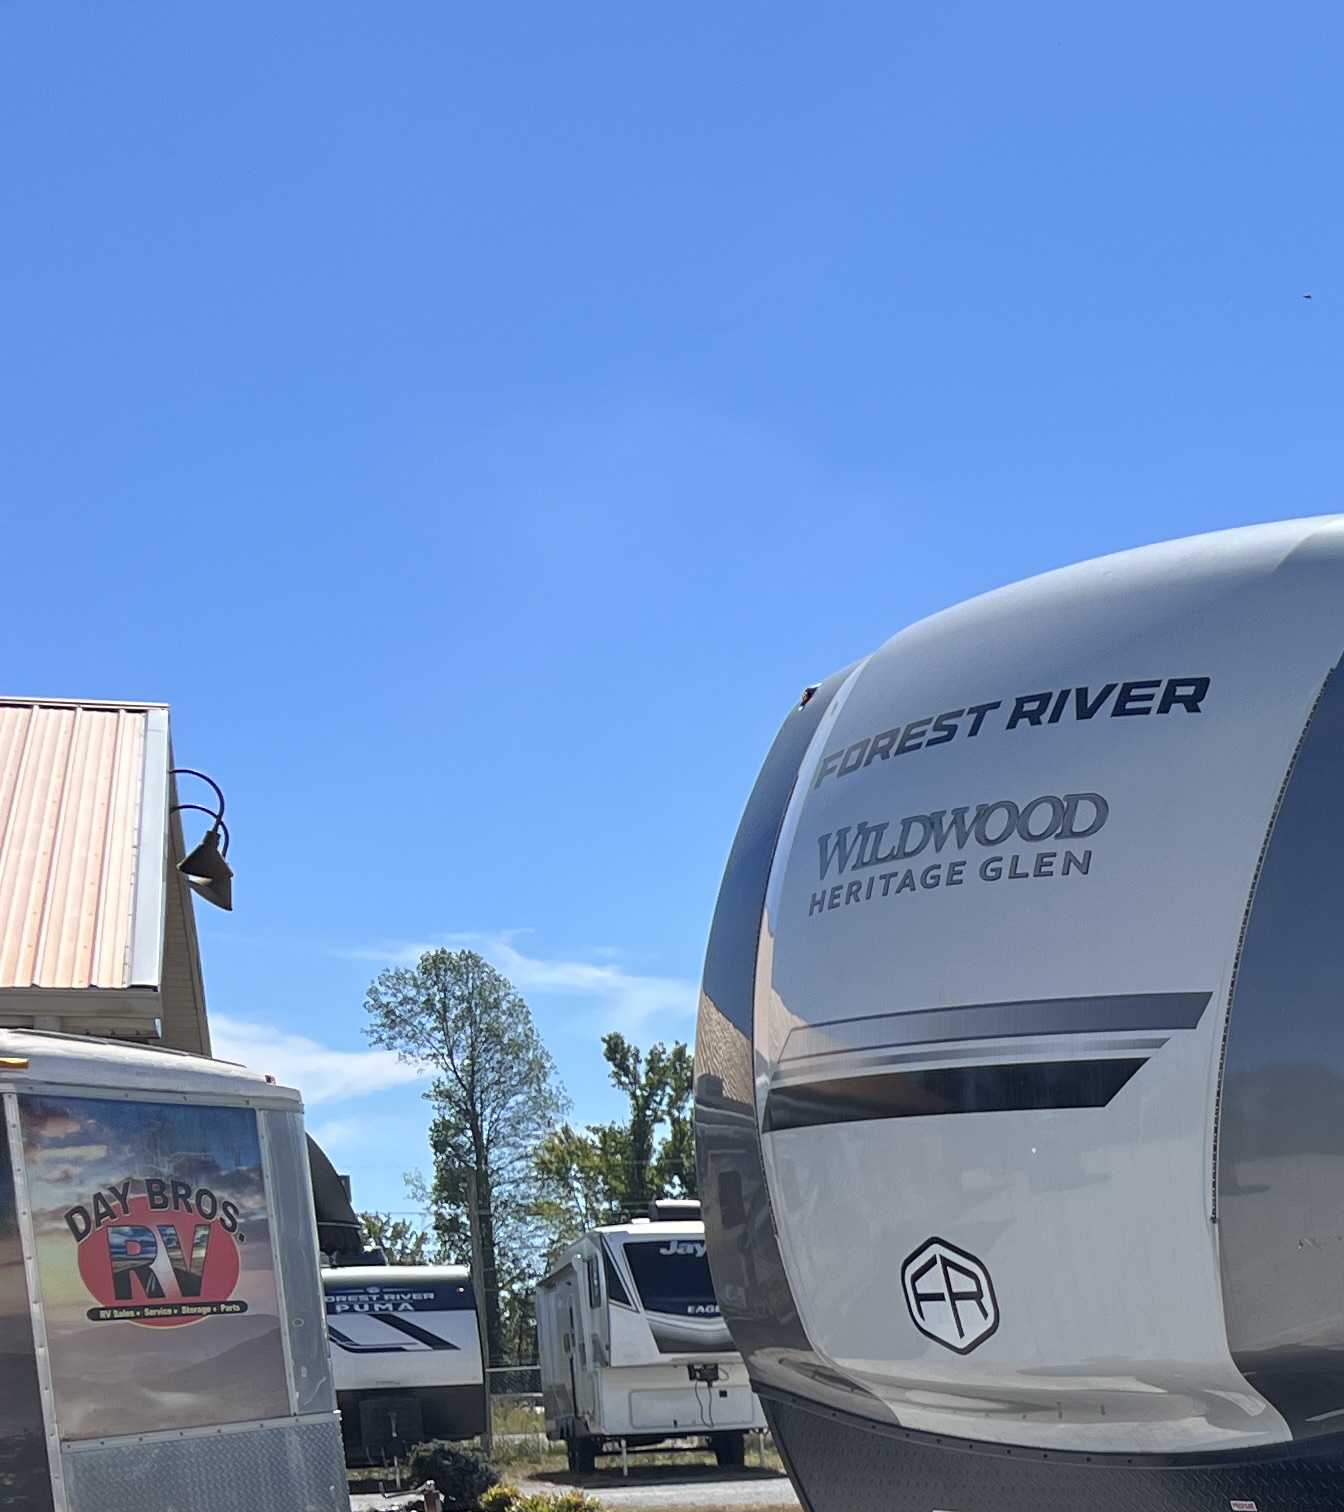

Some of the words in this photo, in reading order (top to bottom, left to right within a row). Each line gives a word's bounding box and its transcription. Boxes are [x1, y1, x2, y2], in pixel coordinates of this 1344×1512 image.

[814, 700, 1002, 791] FOREST
[1004, 676, 1211, 732] RIVER
[817, 793, 1109, 881] WILDWOOD
[808, 860, 967, 917] HERITAGE
[979, 850, 1093, 882] GLEN
[63, 1181, 132, 1243] DAY
[144, 1178, 246, 1243] BROS.
[106, 1224, 212, 1300] RV
[660, 1240, 707, 1257] Jay
[100, 1310, 111, 1319] RV
[112, 1308, 135, 1319] Sales
[144, 1306, 173, 1317] Service
[181, 1304, 212, 1316] Storage
[220, 1303, 241, 1313] Parts
[325, 1294, 379, 1303] OREST
[383, 1292, 435, 1301] RIVER
[336, 1302, 415, 1313] PUMA
[687, 1304, 720, 1314] EAGL
